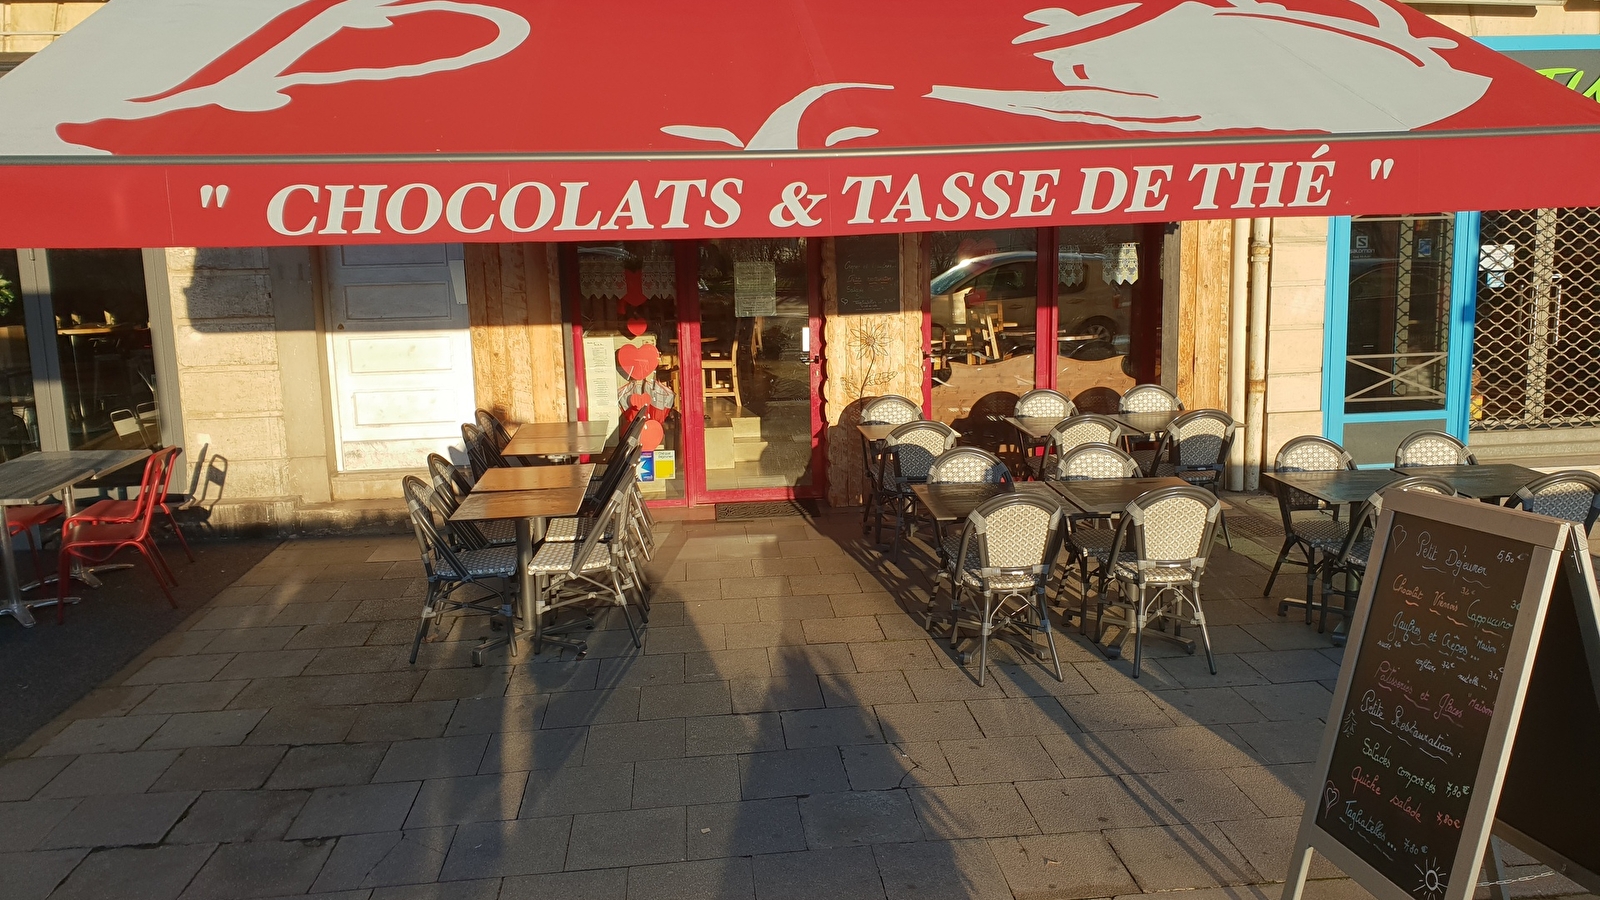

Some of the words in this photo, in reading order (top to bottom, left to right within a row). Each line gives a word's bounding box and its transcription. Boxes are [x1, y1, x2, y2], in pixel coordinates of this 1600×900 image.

[267, 177, 744, 236] CHOCOLATS
[769, 181, 827, 229] &
[842, 169, 1061, 225] TASSE
[1072, 165, 1174, 215] DE
[1189, 145, 1337, 211] THÉ
[1416, 531, 1438, 561] Petit
[1392, 574, 1423, 600] Chocolat
[1466, 598, 1514, 630] Cappuccino
[1427, 630, 1438, 642] et
[1360, 689, 1385, 721] Petite
[1391, 705, 1454, 757] Restauration
[1362, 737, 1391, 768] Salades
[1351, 766, 1382, 795] Quiche
[1389, 795, 1422, 823] salade
